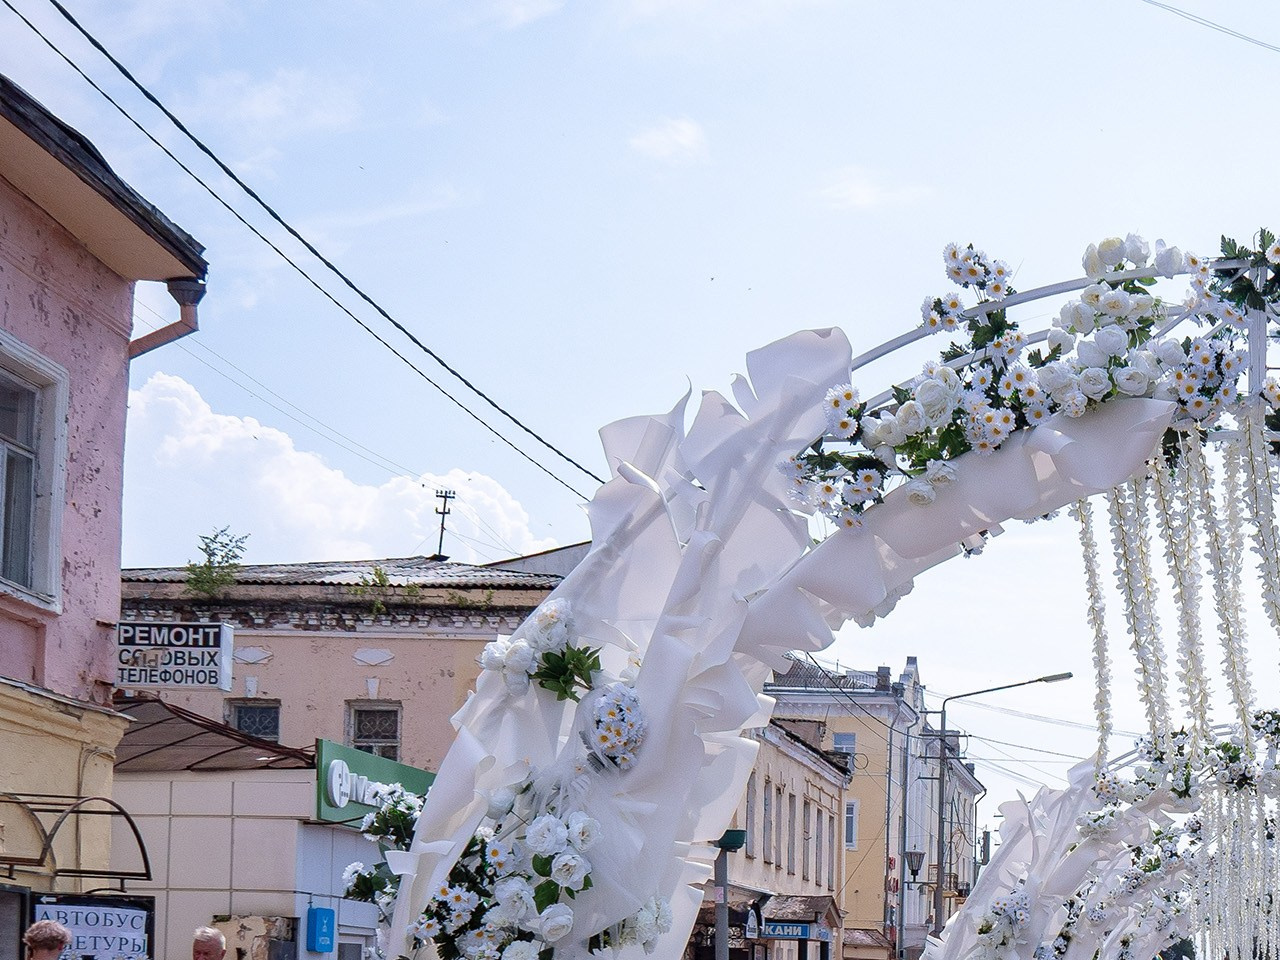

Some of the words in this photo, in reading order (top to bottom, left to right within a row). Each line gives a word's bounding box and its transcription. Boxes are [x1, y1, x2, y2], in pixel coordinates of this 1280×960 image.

[119, 625, 220, 646] РЕМОНТ
[118, 648, 219, 667] СОВЫХ
[117, 667, 219, 685] ТЕЛЕФОНОВ
[40, 910, 144, 930] АВТОБУС
[764, 924, 803, 936] КАНИ
[64, 935, 147, 953] ЕТУРЫ
